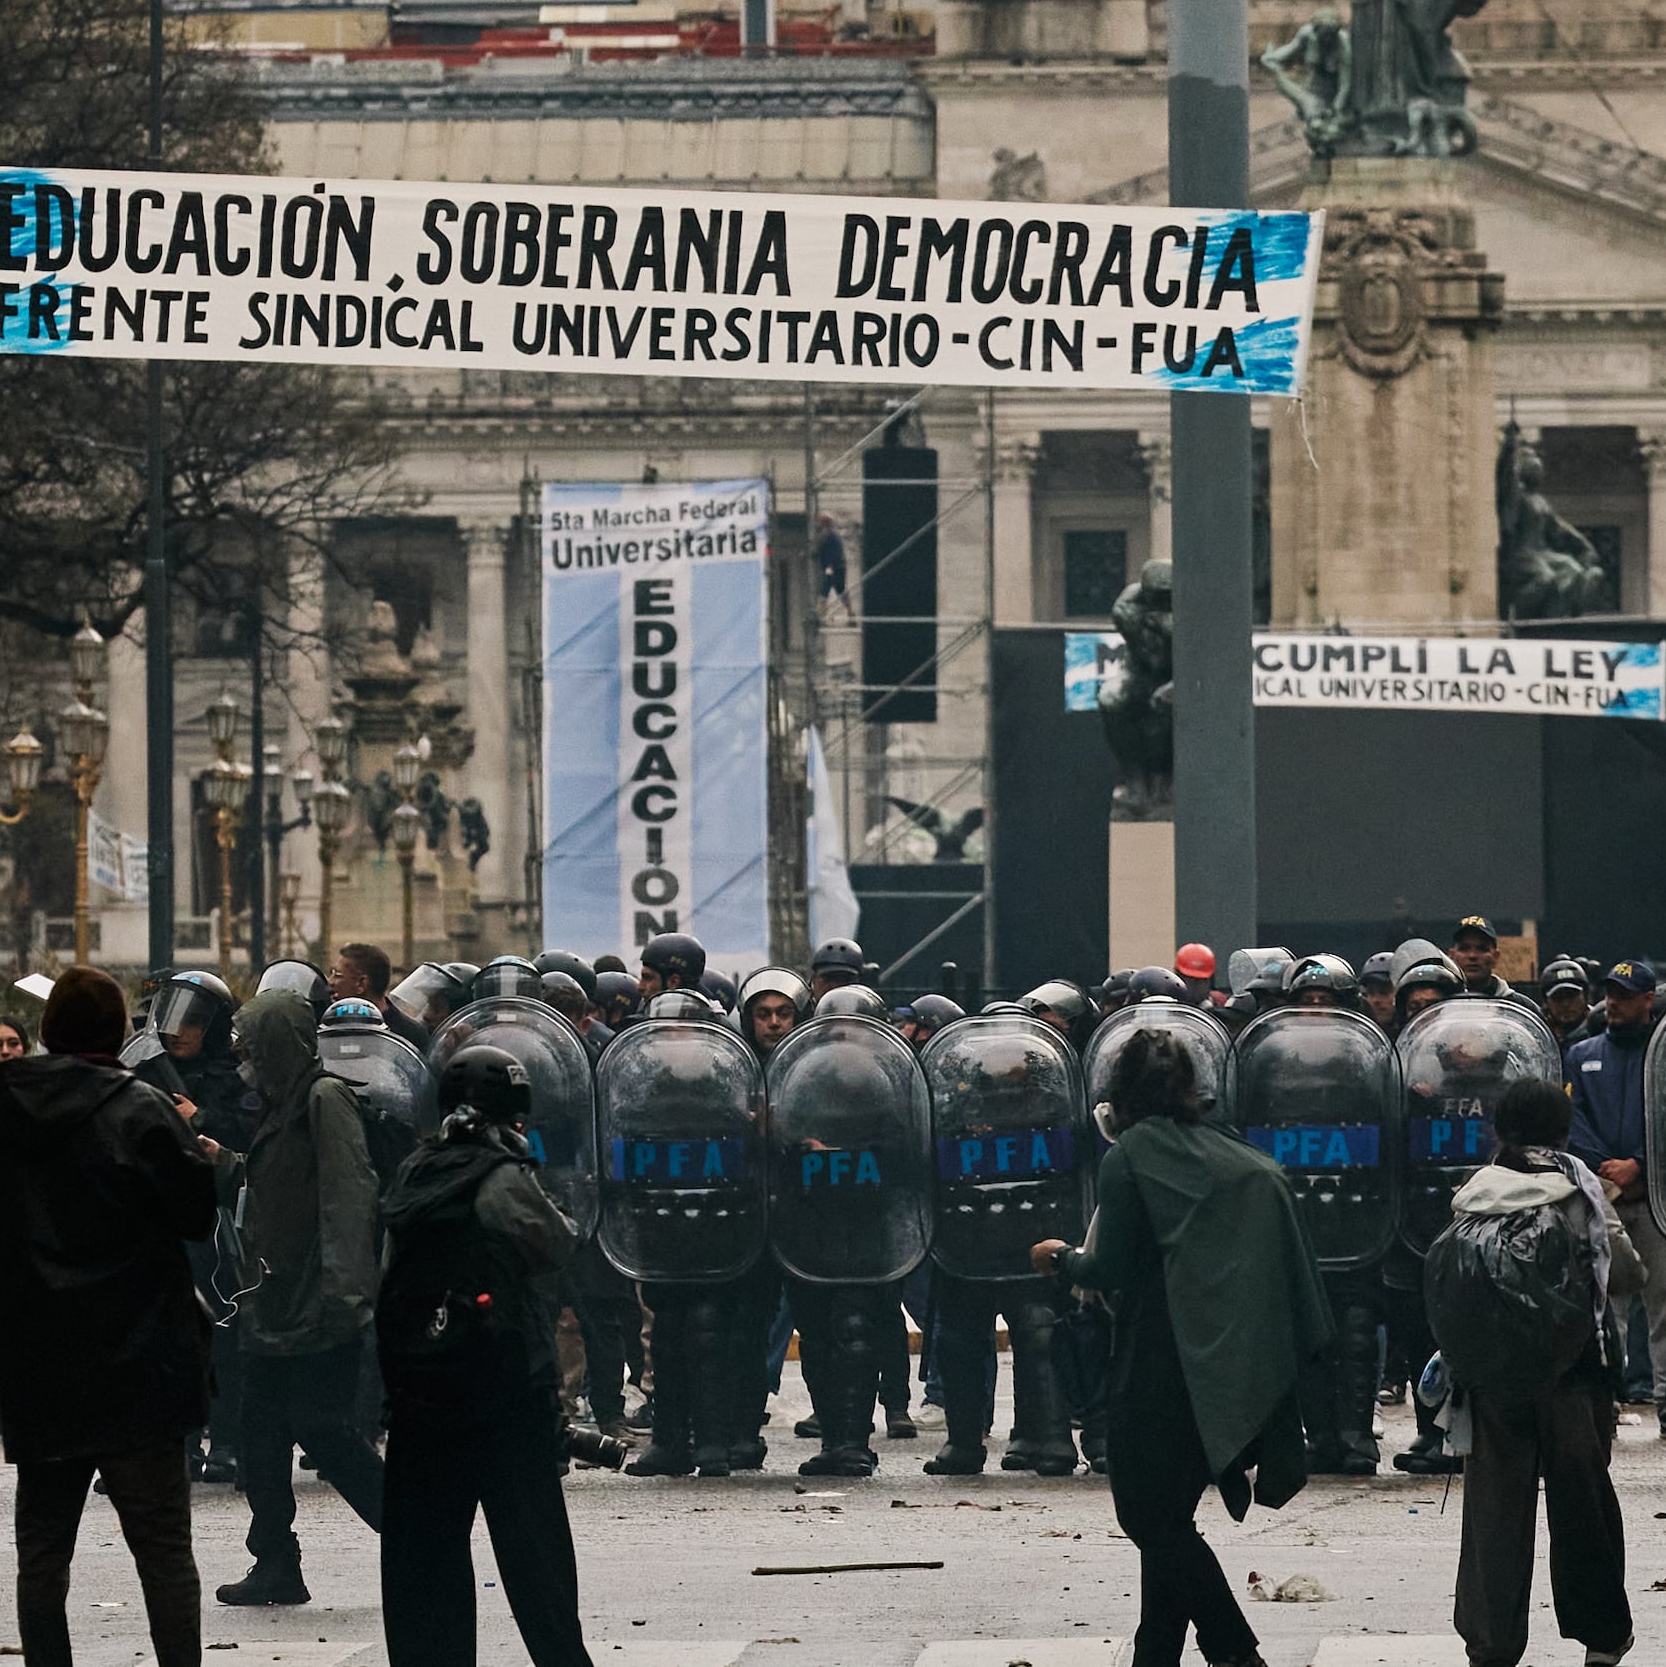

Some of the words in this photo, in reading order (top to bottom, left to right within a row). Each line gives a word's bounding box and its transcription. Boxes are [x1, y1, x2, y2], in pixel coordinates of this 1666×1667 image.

[416, 198, 791, 299] SOBERANIA
[837, 213, 1260, 313] DEMOCRACIA
[238, 291, 484, 352] SINDICAL
[551, 511, 584, 531] 5ta
[592, 505, 671, 527] Marcha
[678, 497, 757, 521] Federal
[551, 526, 758, 571] Universitaria
[1458, 645, 1515, 675] LA
[1544, 648, 1629, 681] LEY
[1460, 915, 1486, 928] PFA
[335, 1004, 371, 1017] PFA
[959, 1134, 1054, 1176] PFA
[1272, 1129, 1351, 1167] PFA
[1431, 1119, 1486, 1155] PF
[634, 1141, 724, 1178] PFA
[801, 1149, 881, 1187] PFA
